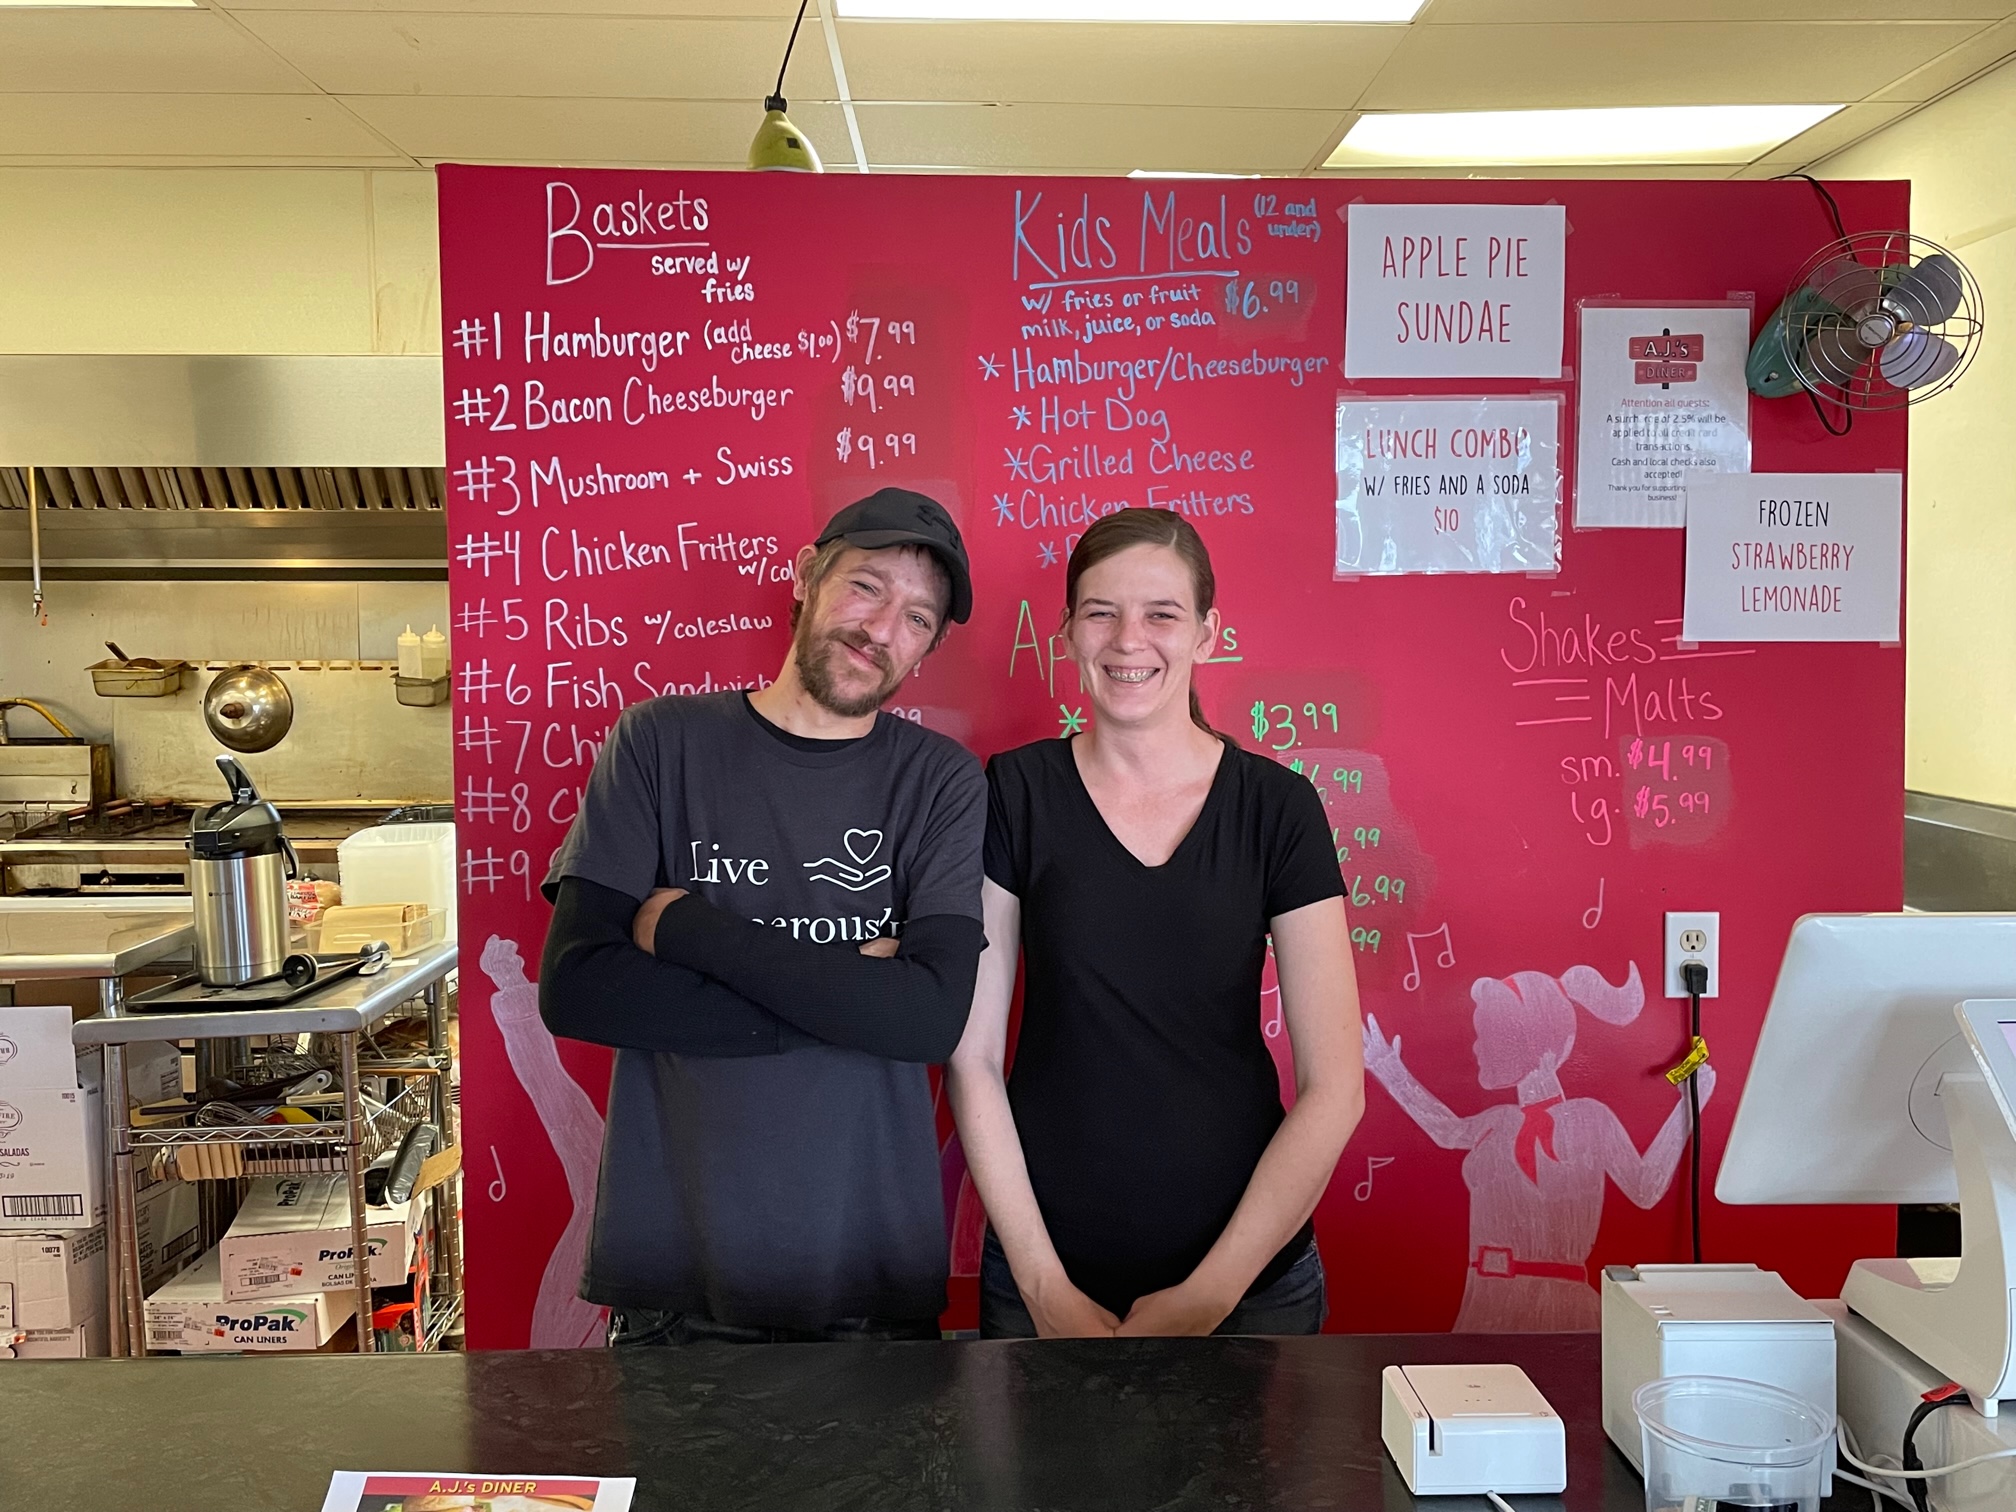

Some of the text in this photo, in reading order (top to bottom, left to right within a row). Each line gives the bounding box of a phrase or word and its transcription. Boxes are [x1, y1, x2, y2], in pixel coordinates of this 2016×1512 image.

[1254, 195, 1317, 218] (12 and
[546, 182, 709, 285] Baskets
[1013, 190, 1252, 280] Kids Meals
[1268, 220, 1321, 242] under)
[651, 251, 751, 280] served w/
[1383, 235, 1528, 279] APPLE PIE
[701, 278, 755, 303] fries
[1022, 284, 1201, 315] w/ fries or fruit
[1224, 278, 1299, 320] $6.99
[452, 311, 753, 372] #1 Hamburger (add
[846, 309, 916, 365] $7.99
[1021, 309, 1216, 344] milk, juice, or soda
[1397, 300, 1511, 344] SUNDAE
[731, 342, 793, 365] cheese
[1644, 340, 1689, 357] A.J.'s
[841, 365, 915, 413] $9.99
[1646, 366, 1686, 379] DINER
[453, 375, 794, 431] #2 Bacon Cheeseburger
[1041, 396, 1171, 444] Hot Dog
[1606, 414, 1613, 423] A
[1615, 414, 1659, 425] surchrge
[1697, 414, 1712, 423] will
[1715, 414, 1726, 423] be
[1621, 399, 1662, 408] Attention
[1664, 399, 1675, 408] all
[836, 427, 916, 470] $9.99
[1028, 442, 1255, 484] Grilled Cheese
[1366, 428, 1528, 459] LUNCH COMBO
[1611, 458, 1631, 466] Cash
[1632, 458, 1648, 466] and
[1649, 458, 1668, 466] local
[1699, 458, 1717, 466] also
[453, 446, 794, 516] #3 Mushroom + Swiss
[1364, 474, 1530, 496] W/ FRIES AND A SODA
[1020, 486, 1254, 530] Chicken Fritters
[1434, 506, 1459, 535] $10
[1759, 499, 1829, 528] FROZEN
[455, 522, 779, 586] #4 Chicken Fritters
[1731, 541, 1855, 571] STRAWBERRY
[1741, 584, 1842, 613] LEMONADE
[454, 598, 528, 641] #5
[545, 598, 628, 650] Ribs
[1500, 596, 1657, 673] Shakes
[457, 658, 532, 705] #6
[547, 661, 624, 710] Fish
[1250, 701, 1338, 750] $3.99
[1605, 672, 1724, 740] Malts
[457, 715, 532, 774] #7
[1560, 737, 1713, 785] sm. $4.99
[460, 775, 531, 833] #8
[1571, 785, 1710, 846] lg. $5.99
[461, 846, 530, 902] #9
[689, 840, 770, 886] Live
[318, 1246, 378, 1262] ProPk
[215, 1313, 296, 1332] ProPak
[233, 1335, 287, 1344] CAN LINERS
[429, 1480, 537, 1494] A.J.'s DINER
